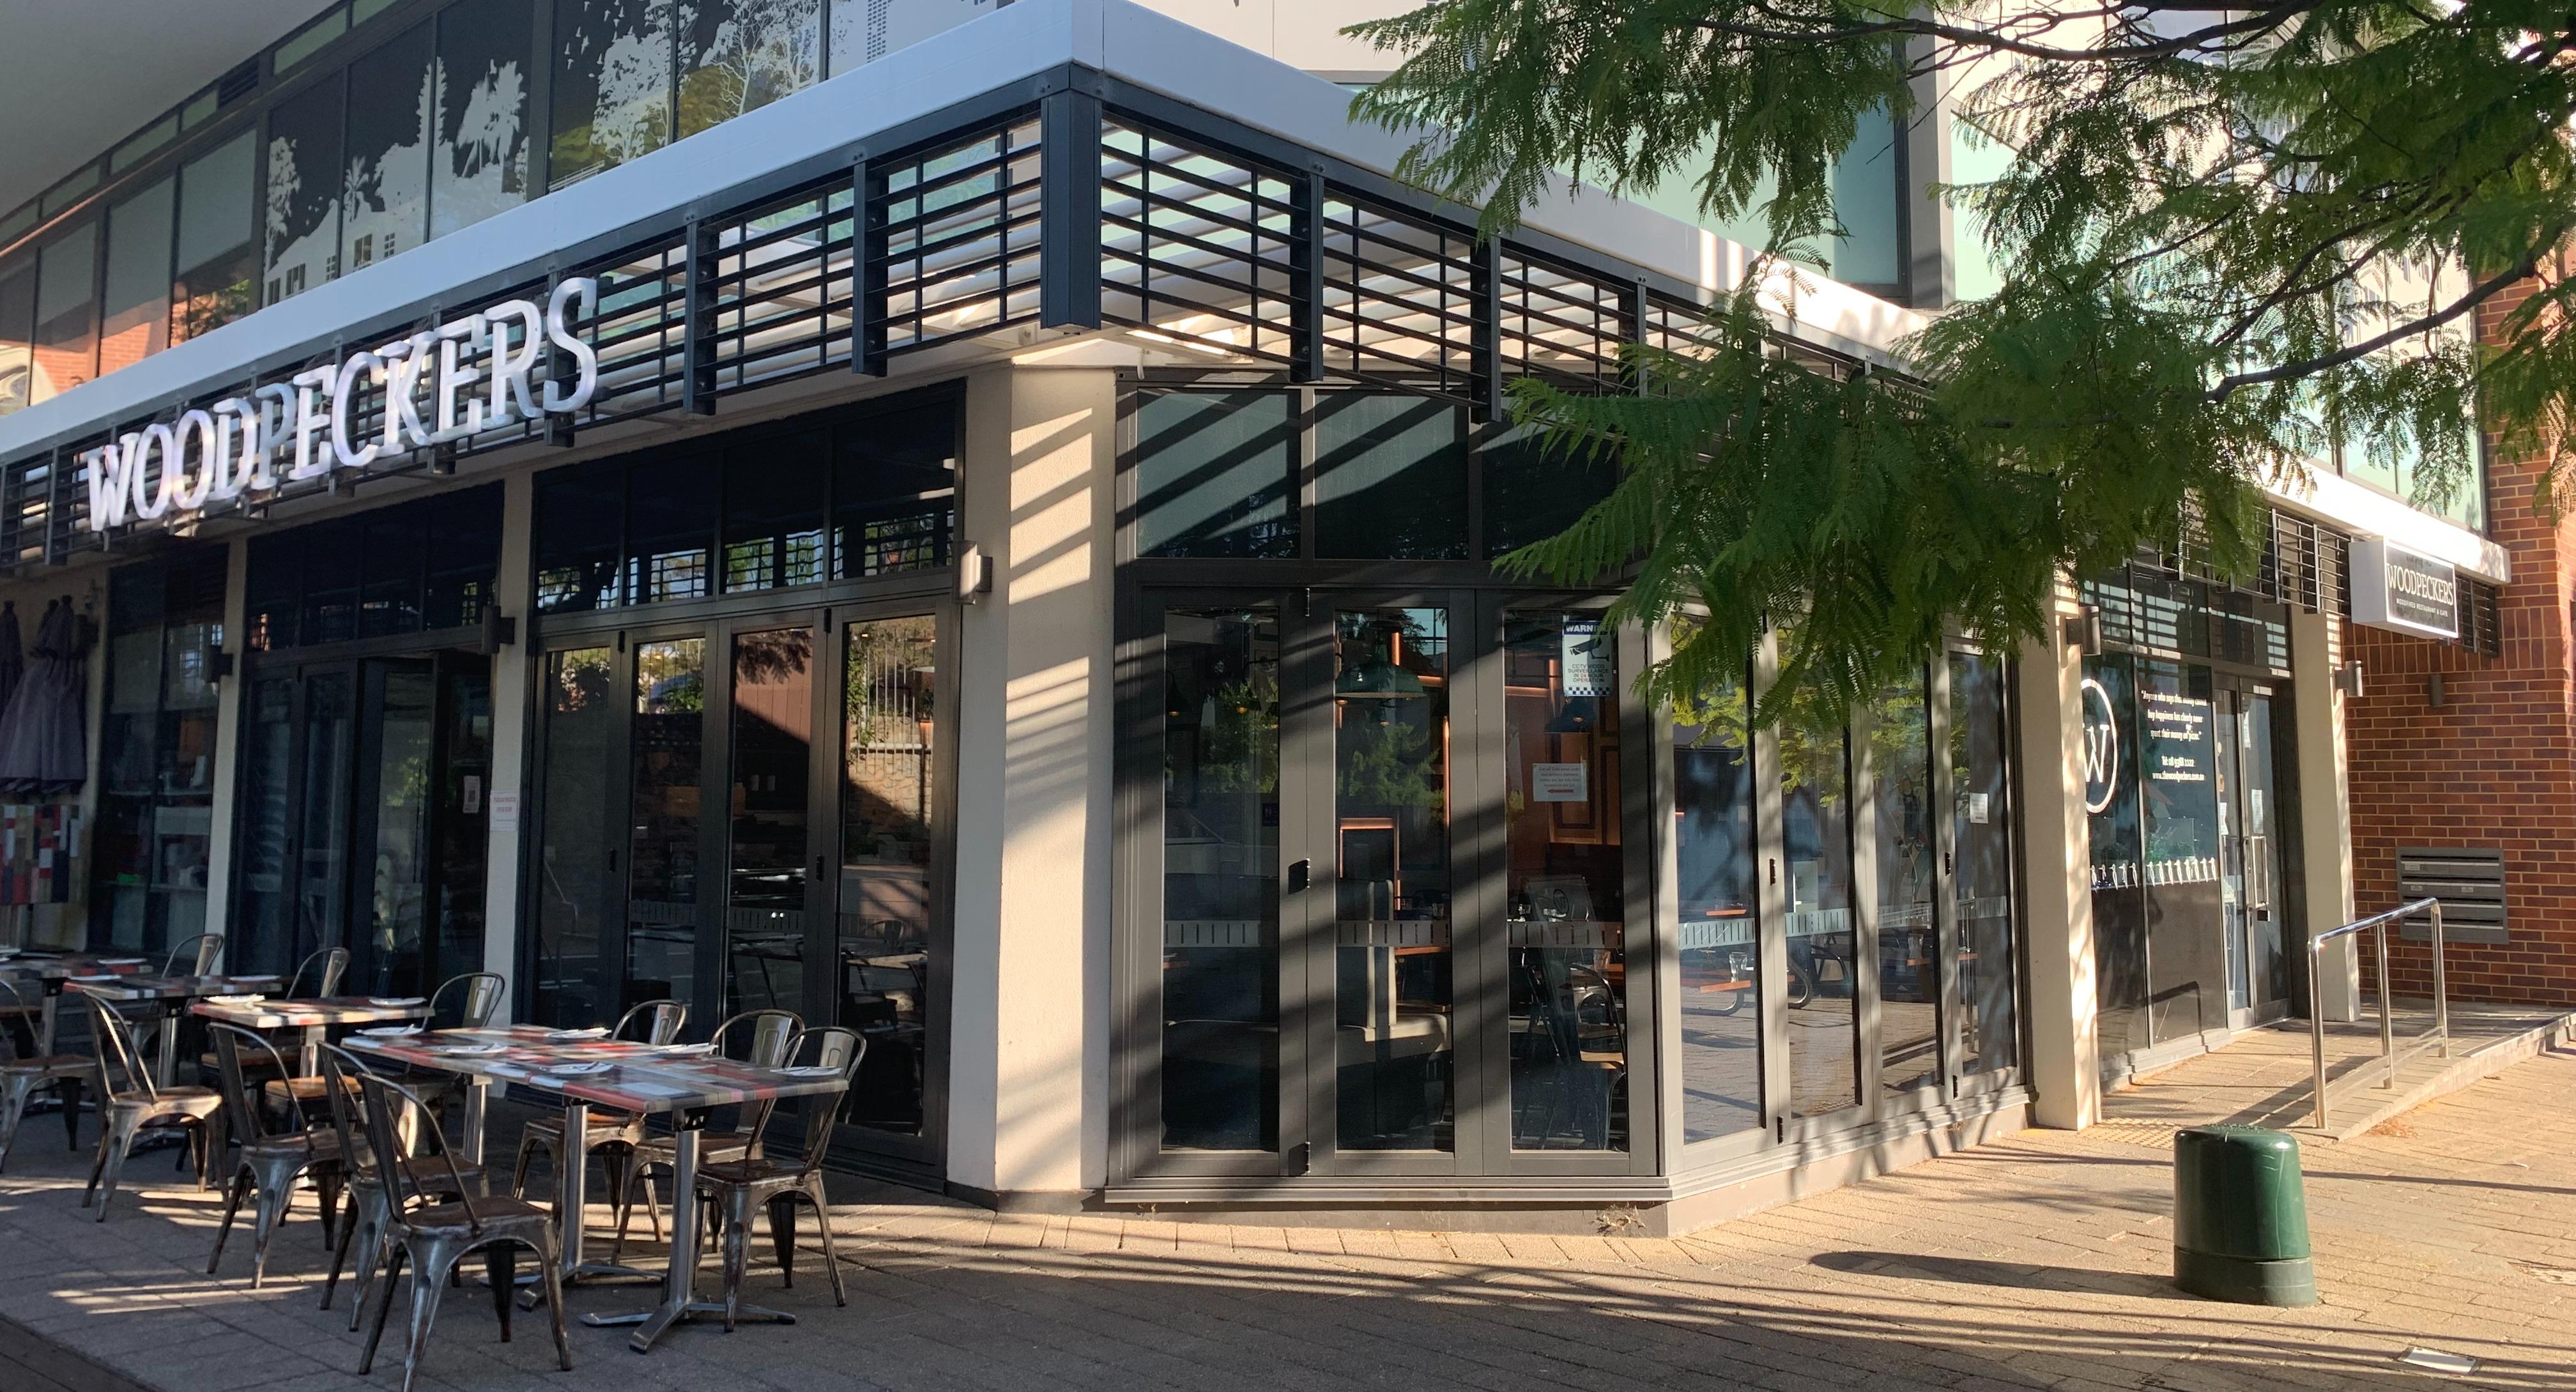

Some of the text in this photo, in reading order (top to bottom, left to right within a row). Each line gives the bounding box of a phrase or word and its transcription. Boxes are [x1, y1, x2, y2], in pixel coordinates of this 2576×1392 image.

[88, 277, 598, 532] WOODPECKERS
[2386, 563, 2453, 606] WOODPECKERS
[2416, 602, 2436, 613] RESTAURANT
[2166, 695, 2174, 705] says
[2182, 698, 2194, 707] money
[2156, 710, 2174, 722] happiness
[2181, 712, 2193, 724] clearly
[2150, 730, 2161, 739] spent
[2161, 728, 2170, 738] their
[2170, 731, 2182, 741] money
[2168, 756, 2174, 766] 08
